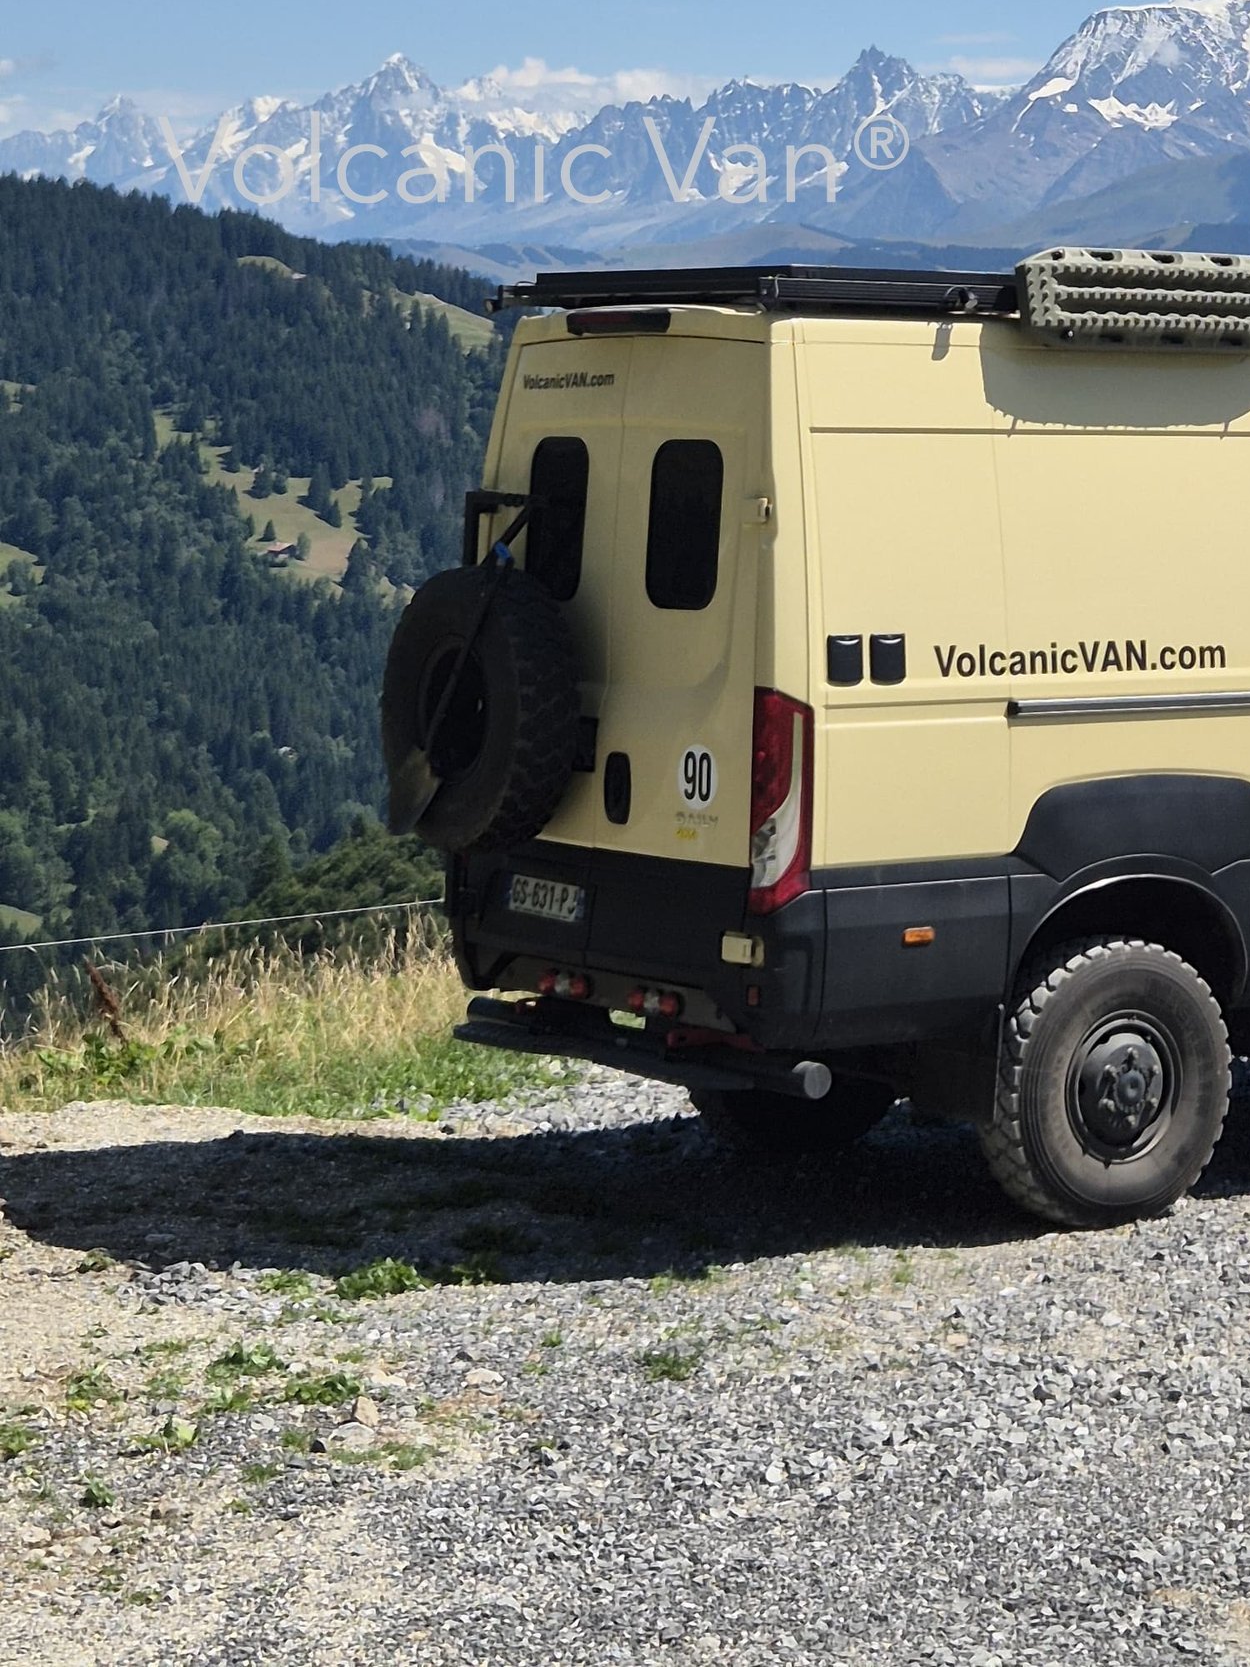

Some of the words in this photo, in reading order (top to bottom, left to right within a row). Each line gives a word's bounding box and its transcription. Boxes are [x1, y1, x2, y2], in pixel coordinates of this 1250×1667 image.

[523, 371, 616, 390] VolcanicVAN.com
[933, 639, 1227, 678] VolcanicVAN.com
[683, 750, 712, 802] 90
